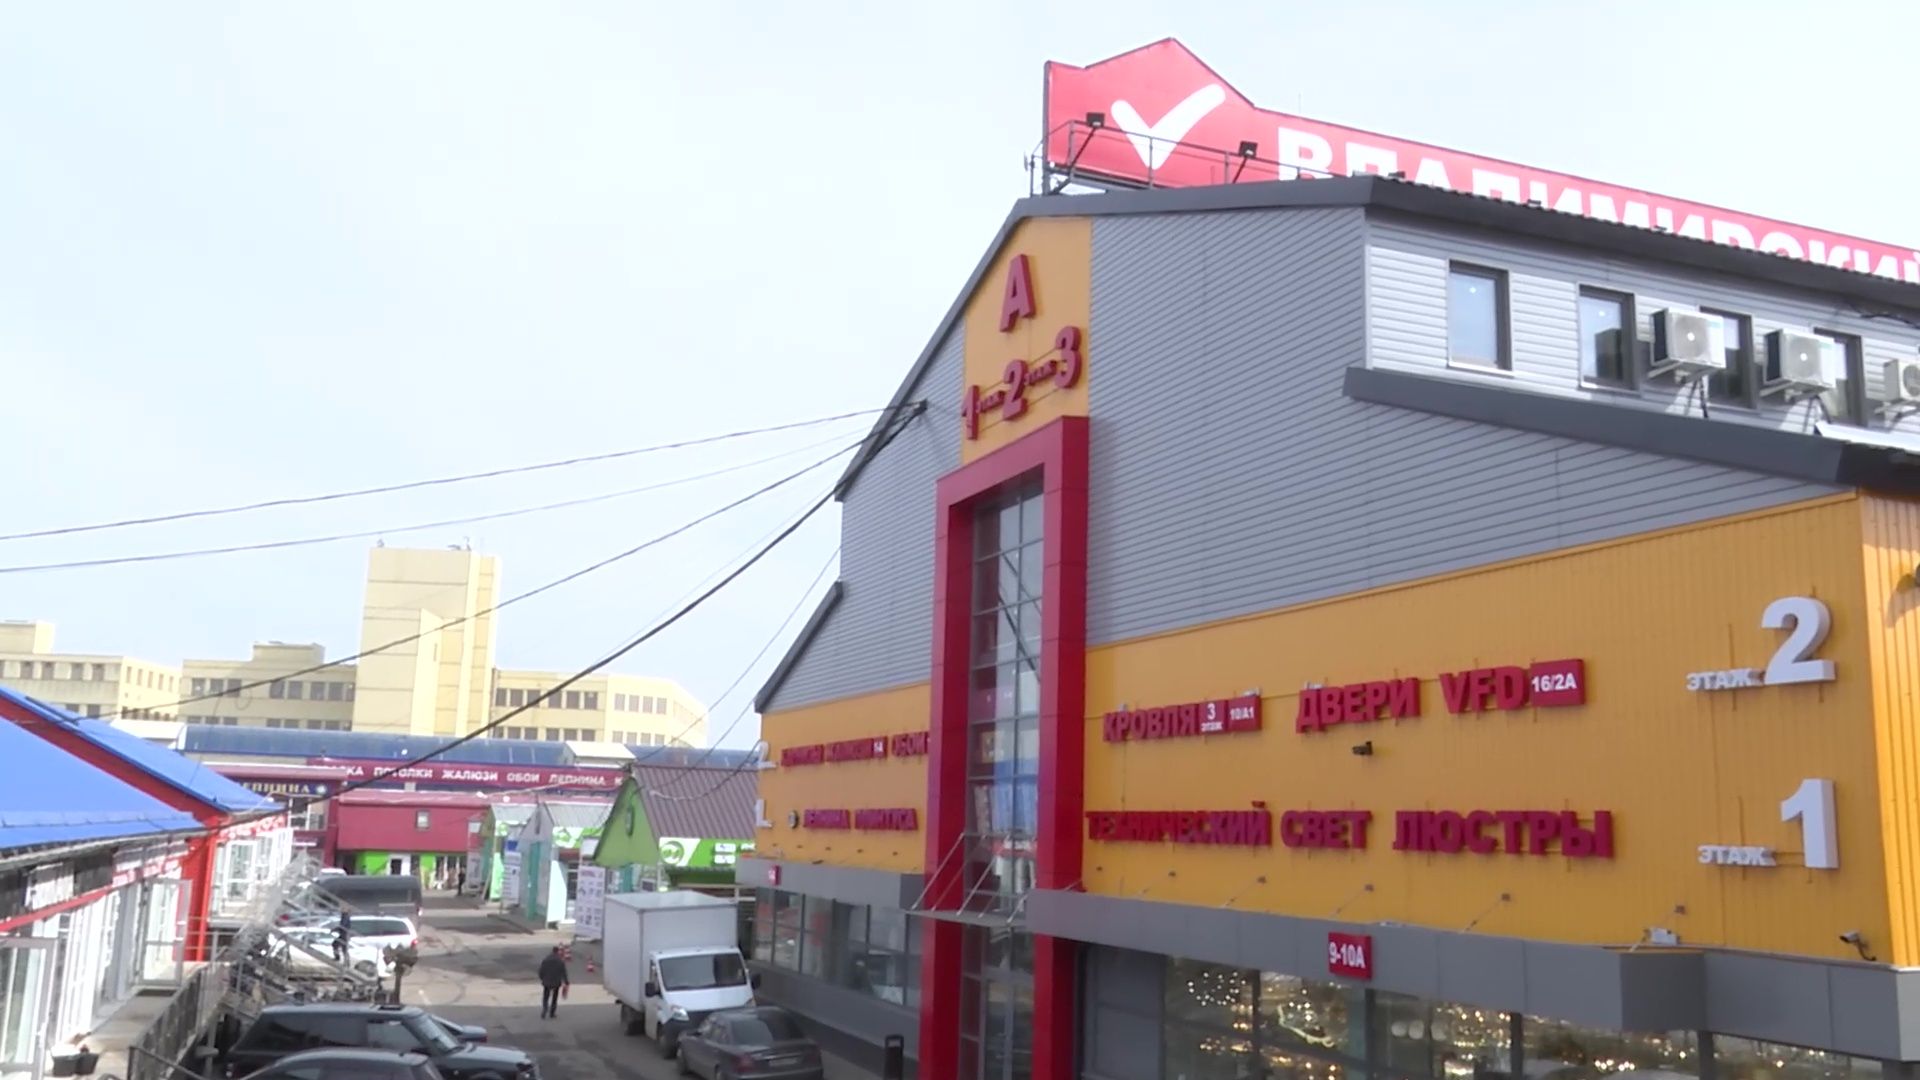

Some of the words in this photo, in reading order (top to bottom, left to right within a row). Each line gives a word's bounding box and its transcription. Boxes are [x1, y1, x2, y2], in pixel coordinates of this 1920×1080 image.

[1000, 254, 1036, 333] А
[1003, 359, 1028, 421] 2
[1055, 326, 1081, 389] 3
[1686, 668, 1763, 690] ЭТАЖ
[1761, 596, 1836, 685] 2
[1104, 703, 1200, 743] КРОВЛЯ
[1207, 703, 1216, 720] 3
[1296, 677, 1421, 733] ДВЕРИ
[1439, 665, 1530, 714] VFD
[373, 766, 434, 779] ПООЛКИ
[442, 769, 498, 782] ЖАЛЮЗИ
[506, 772, 540, 784] ОБОИ
[1281, 810, 1373, 850] СВЕТ
[1393, 810, 1615, 859] ЛЮСТРЫ
[1698, 845, 1776, 866] ЭТАЖ
[1781, 778, 1839, 869] 1
